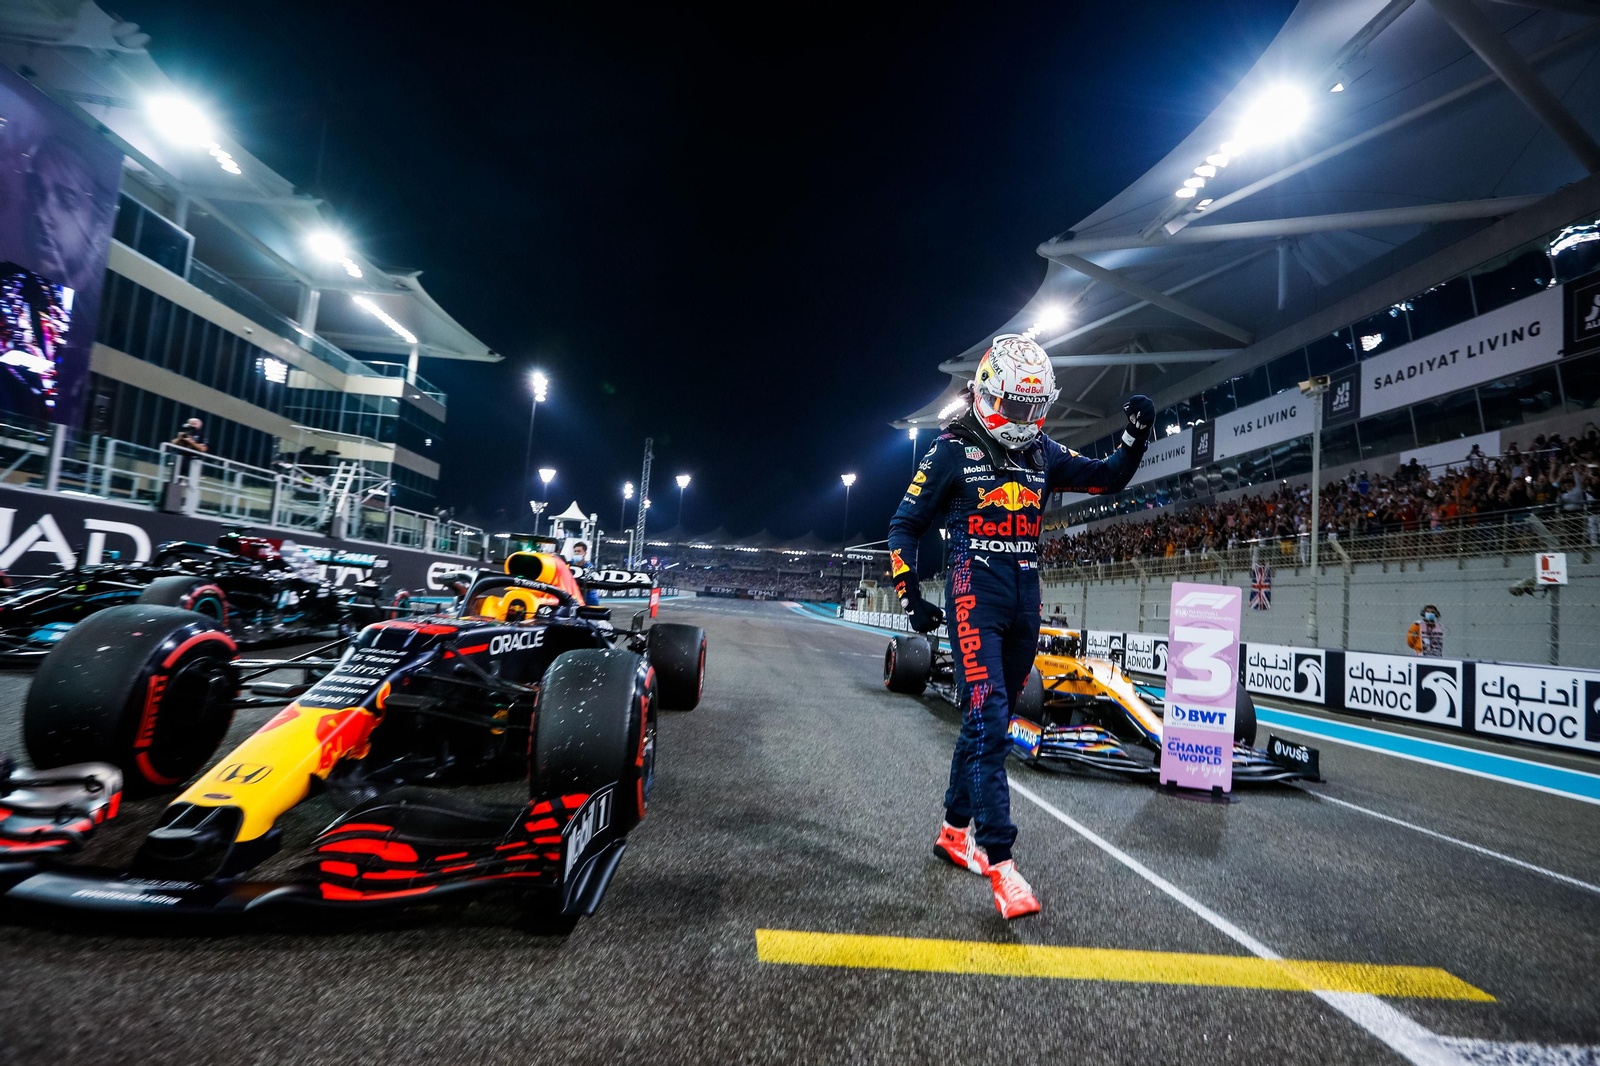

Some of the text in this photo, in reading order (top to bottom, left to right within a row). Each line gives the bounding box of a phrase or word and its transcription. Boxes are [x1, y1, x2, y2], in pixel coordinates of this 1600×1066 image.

[1374, 321, 1541, 390] SAADIYAT LIVING
[1015, 384, 1044, 394] Red Bull
[1007, 394, 1047, 403] HONDA
[1233, 406, 1297, 437] YAS LIVING
[1161, 446, 1186, 462] LIVING
[964, 465, 986, 474] Mobil
[965, 475, 996, 483] ORACLE
[968, 513, 1012, 536] Red
[847, 553, 874, 561] ETIHAD
[571, 566, 653, 585] ONDA
[1175, 591, 1237, 609] F1
[489, 629, 545, 656] ORACLE
[954, 594, 989, 683] Red Bull
[1127, 639, 1153, 654] أدنوك
[358, 648, 408, 656] ORACLE
[1172, 625, 1234, 697] 3
[1127, 655, 1152, 669] ADNOC
[1249, 652, 1292, 672] أدنوك
[1249, 671, 1292, 692] ADNOC
[1349, 661, 1413, 686] أدنوك
[1349, 685, 1412, 711] ADNOC
[1481, 675, 1579, 708] أدنوك
[1188, 709, 1227, 726] BWT
[1481, 704, 1578, 738] ADNOC
[1167, 741, 1222, 757] CHANGE
[1178, 753, 1222, 765] WORLD
